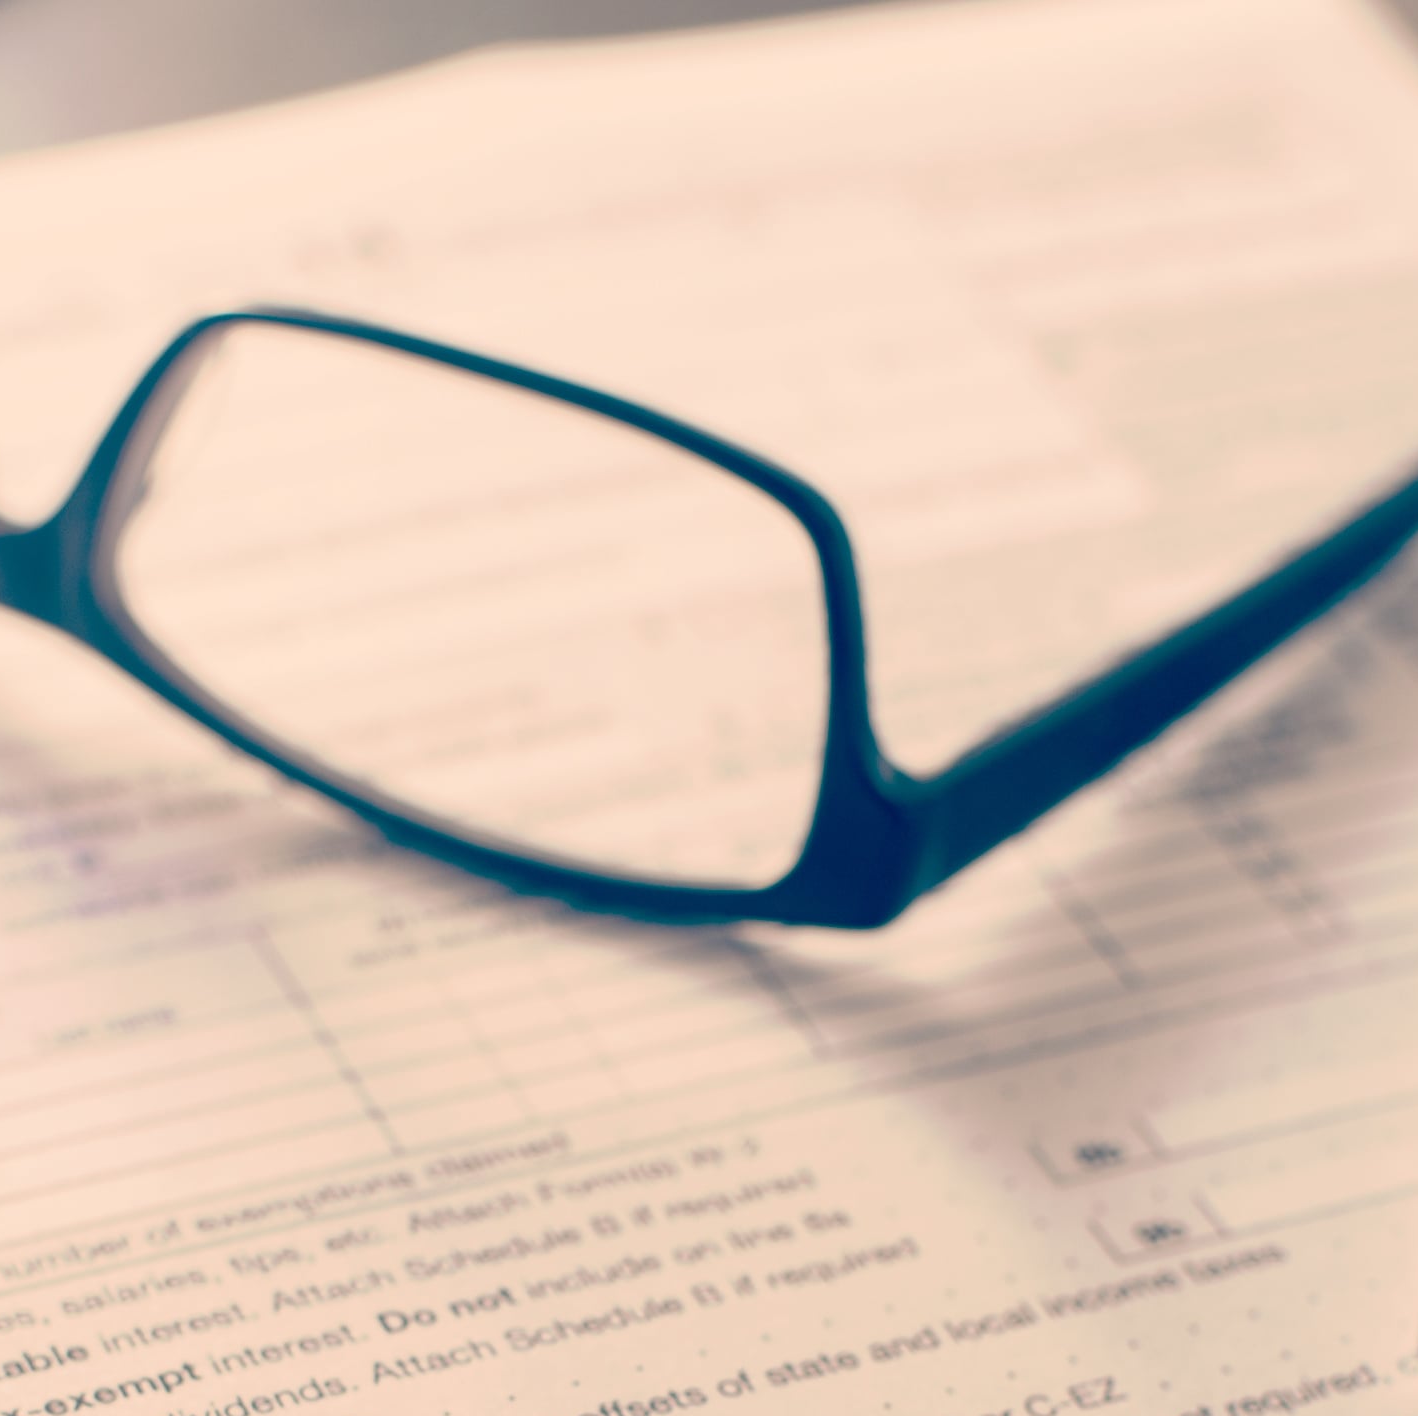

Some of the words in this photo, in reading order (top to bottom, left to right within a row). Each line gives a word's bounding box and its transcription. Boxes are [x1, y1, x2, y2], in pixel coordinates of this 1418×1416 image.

[99, 1301, 248, 1354] interest.
[271, 1268, 397, 1313] Attach
[209, 1323, 356, 1375] interest.
[374, 1308, 438, 1335] Do
[447, 1285, 517, 1319] not
[371, 1339, 498, 1385] Attach
[502, 1296, 685, 1352] Schedule
[715, 1367, 756, 1398] of
[763, 1351, 861, 1387] state
[867, 1324, 942, 1363] and
[942, 1301, 1037, 1343] local
